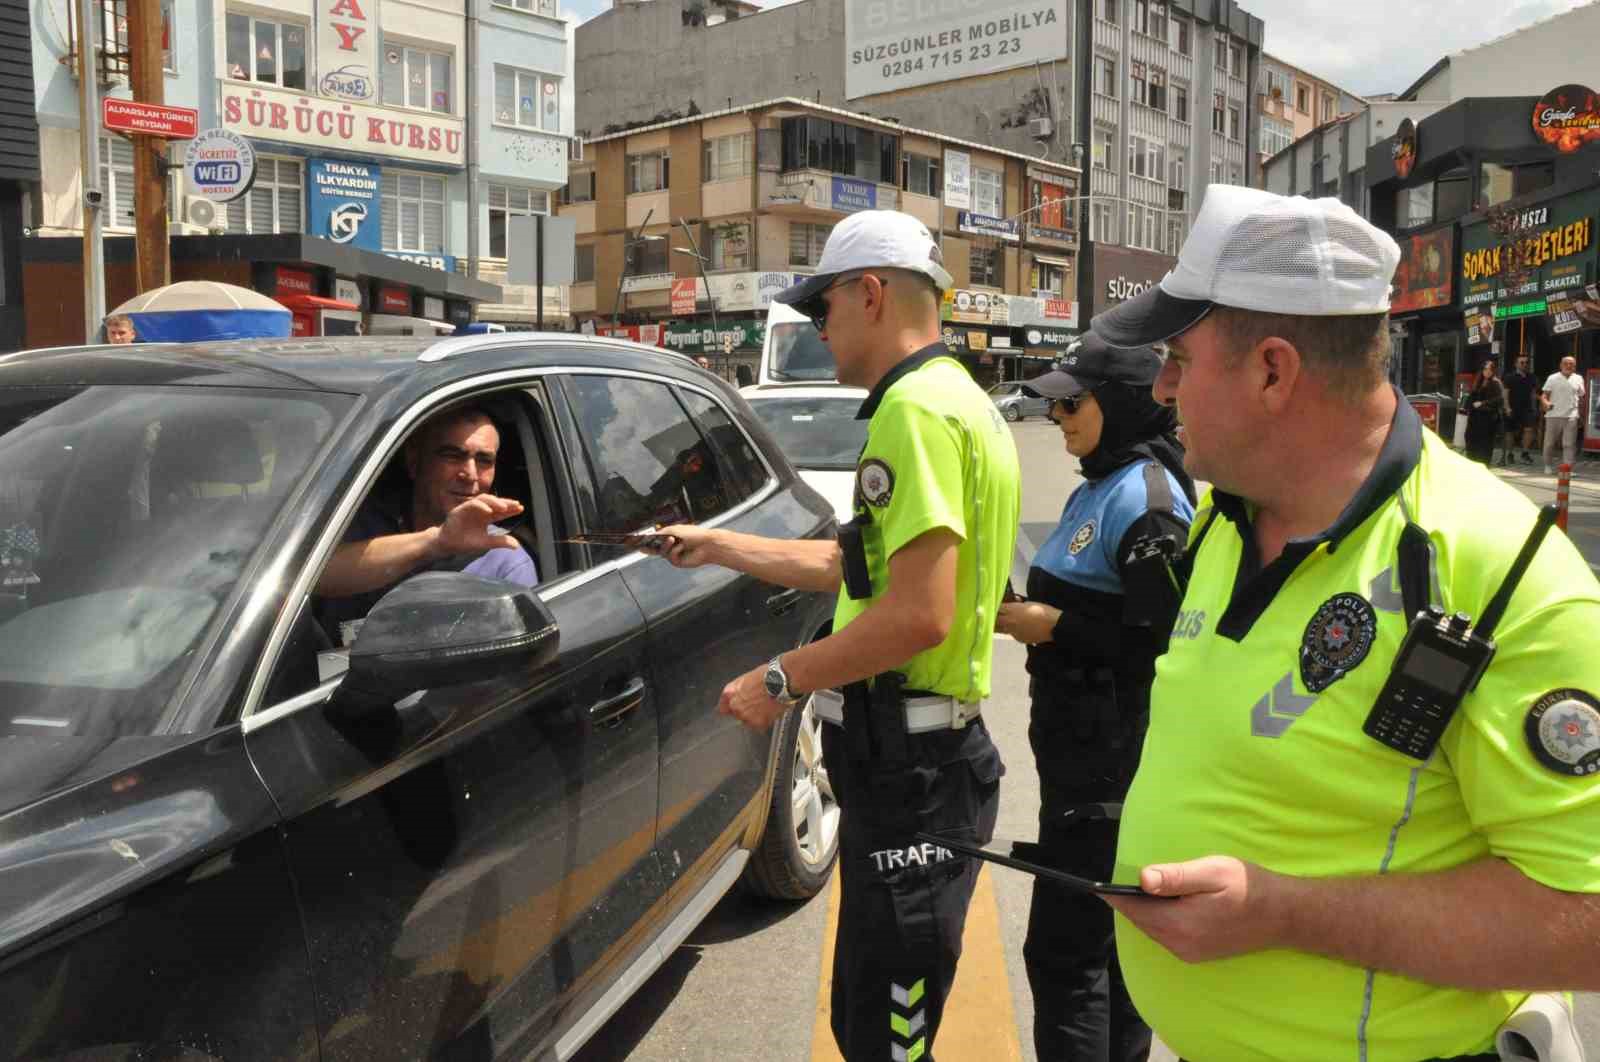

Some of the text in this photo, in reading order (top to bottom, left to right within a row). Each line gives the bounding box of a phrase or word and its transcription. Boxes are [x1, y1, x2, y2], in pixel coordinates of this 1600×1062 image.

[852, 8, 1057, 65] SÜZGÜNLER MOBİLYA
[882, 38, 1021, 78] 0284 715 23 23
[108, 104, 193, 125] ALPARSLAN TÜRKEŞ
[131, 119, 172, 130] MEYDANI
[225, 91, 462, 153] SÜRÜCÜ KURSU
[197, 166, 233, 181] WiFi
[325, 163, 369, 177] TRAKYA
[316, 172, 377, 190] İLKYARDIM
[1463, 246, 1501, 281] SOKAK
[1544, 274, 1582, 290] SAKATAT
[664, 328, 700, 348] Peynir
